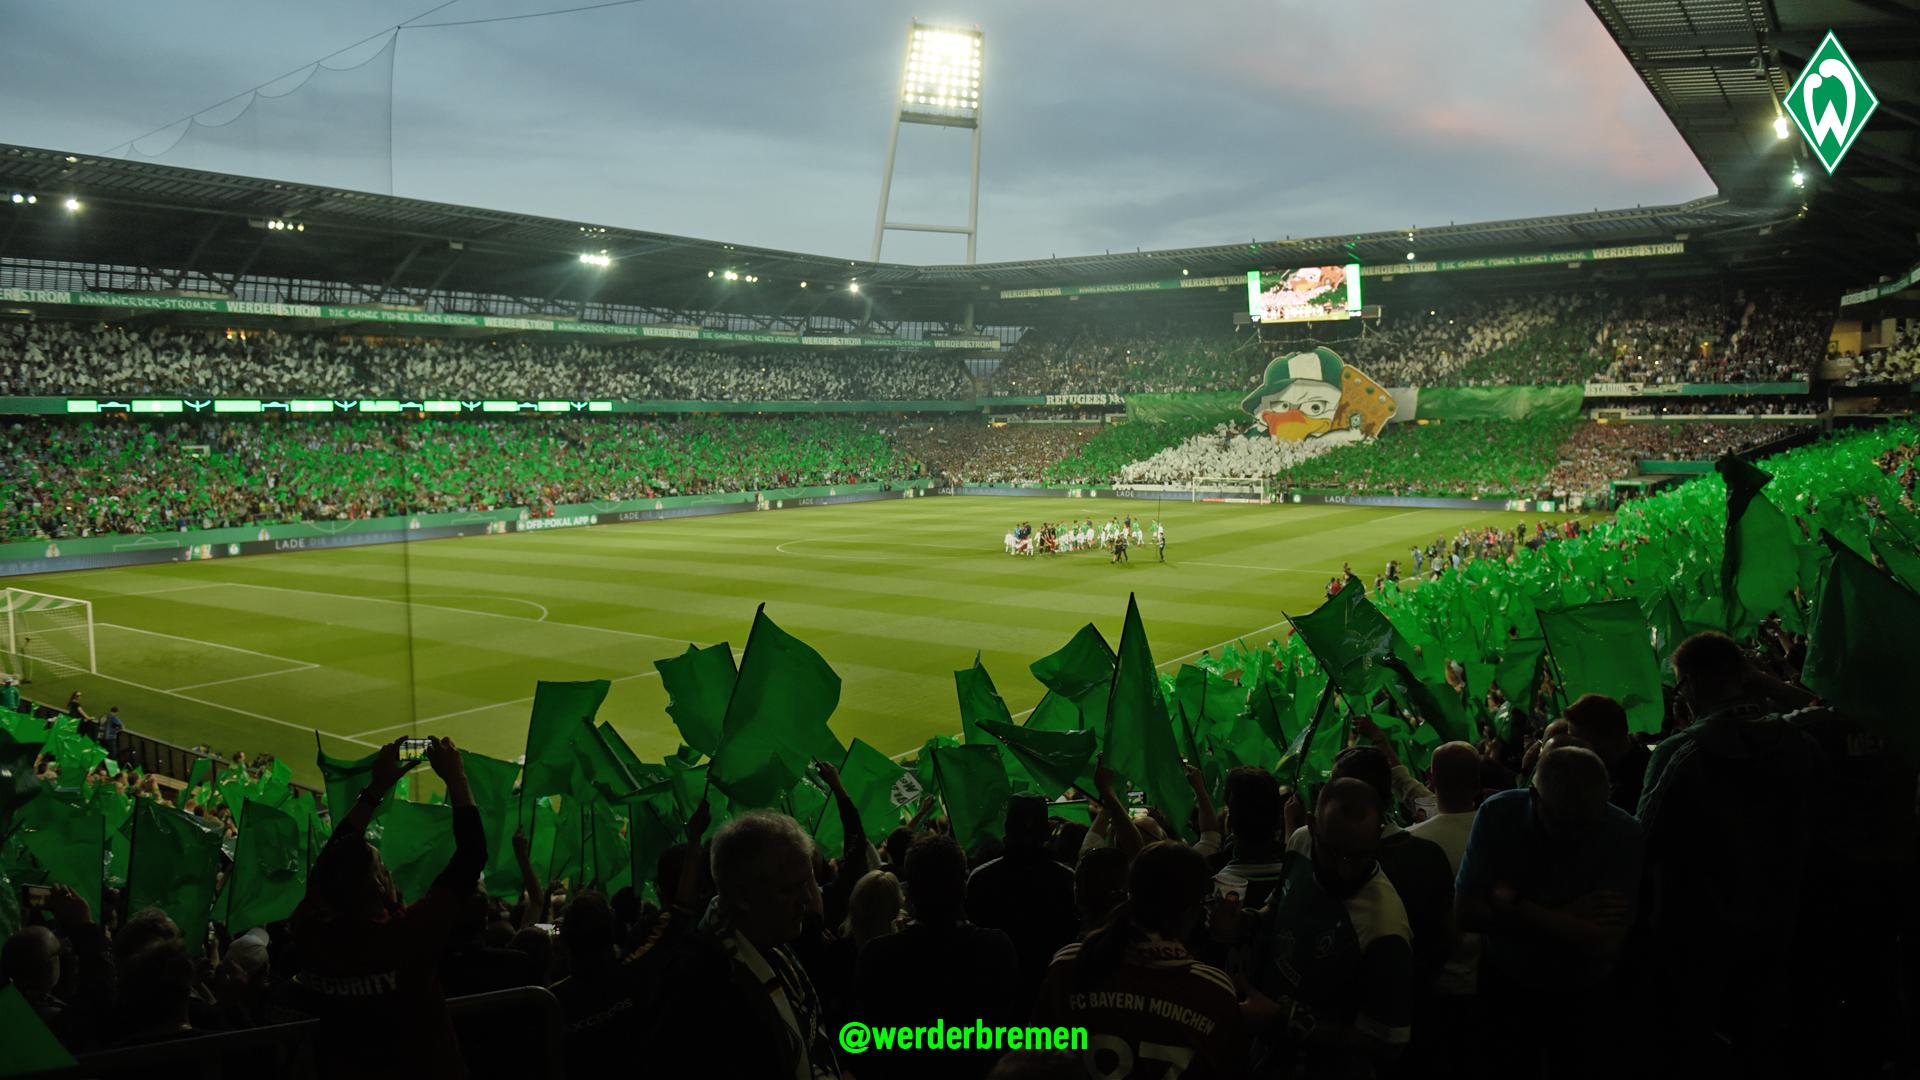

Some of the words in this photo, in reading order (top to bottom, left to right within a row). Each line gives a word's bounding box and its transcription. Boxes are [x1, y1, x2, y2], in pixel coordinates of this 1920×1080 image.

[1046, 394, 1107, 405] REFUGEES
[526, 517, 572, 529] DFB-POKAL
[573, 515, 589, 525] APP
[275, 538, 305, 550] LADE
[1070, 994, 1087, 1010] FC
[1089, 992, 1146, 1011] BAYERN
